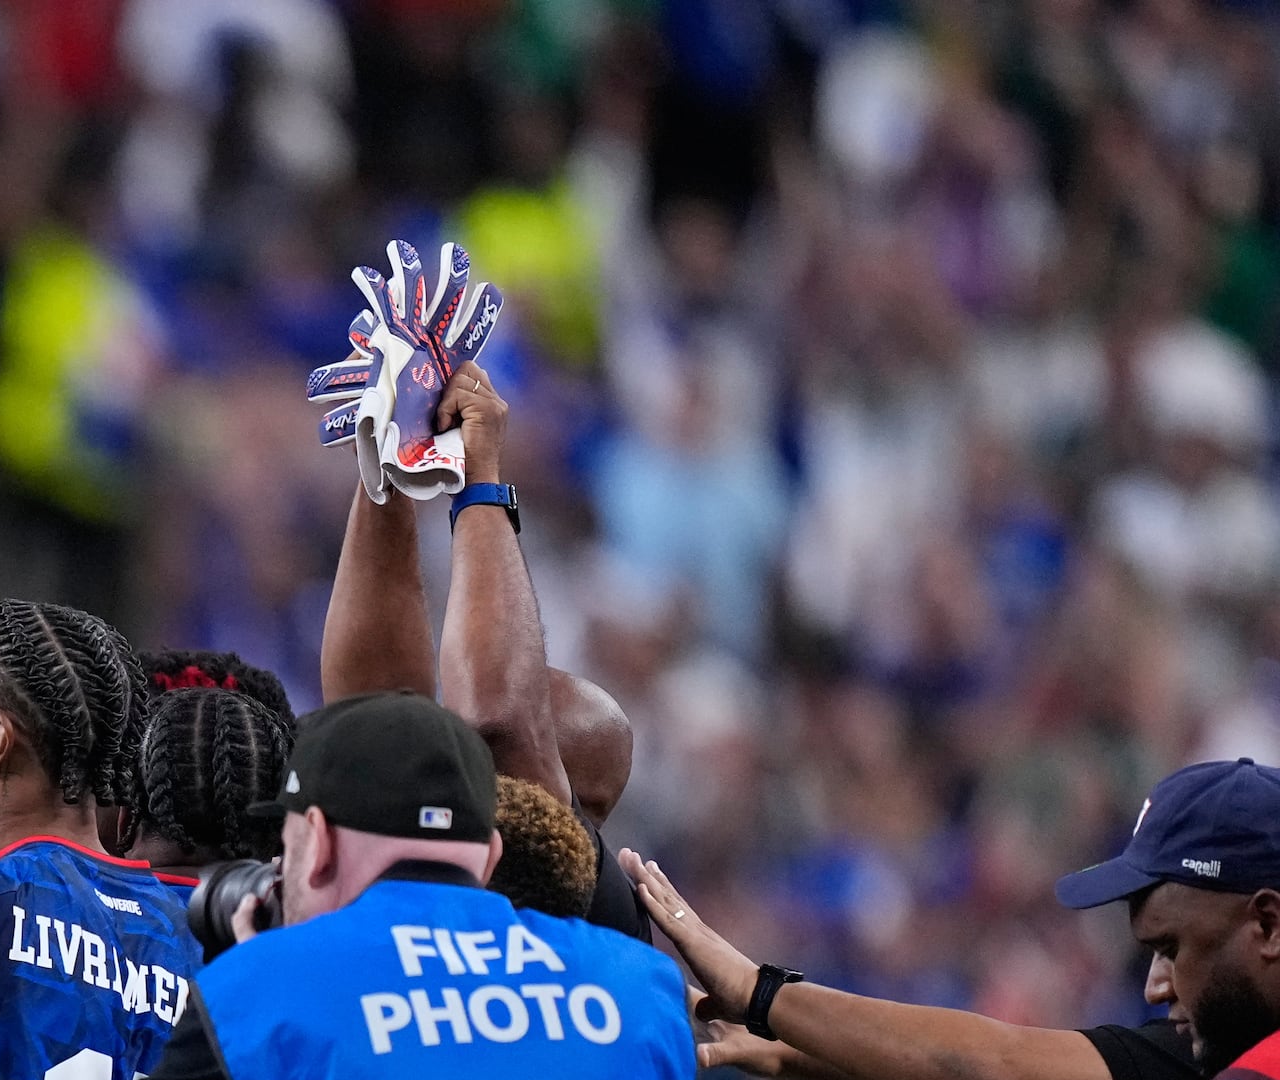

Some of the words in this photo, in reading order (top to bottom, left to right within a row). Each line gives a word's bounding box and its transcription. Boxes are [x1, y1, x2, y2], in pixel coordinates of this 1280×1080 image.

[323, 410, 358, 433] ENDA
[390, 923, 567, 978] FIFA
[359, 983, 622, 1055] PHOTO
